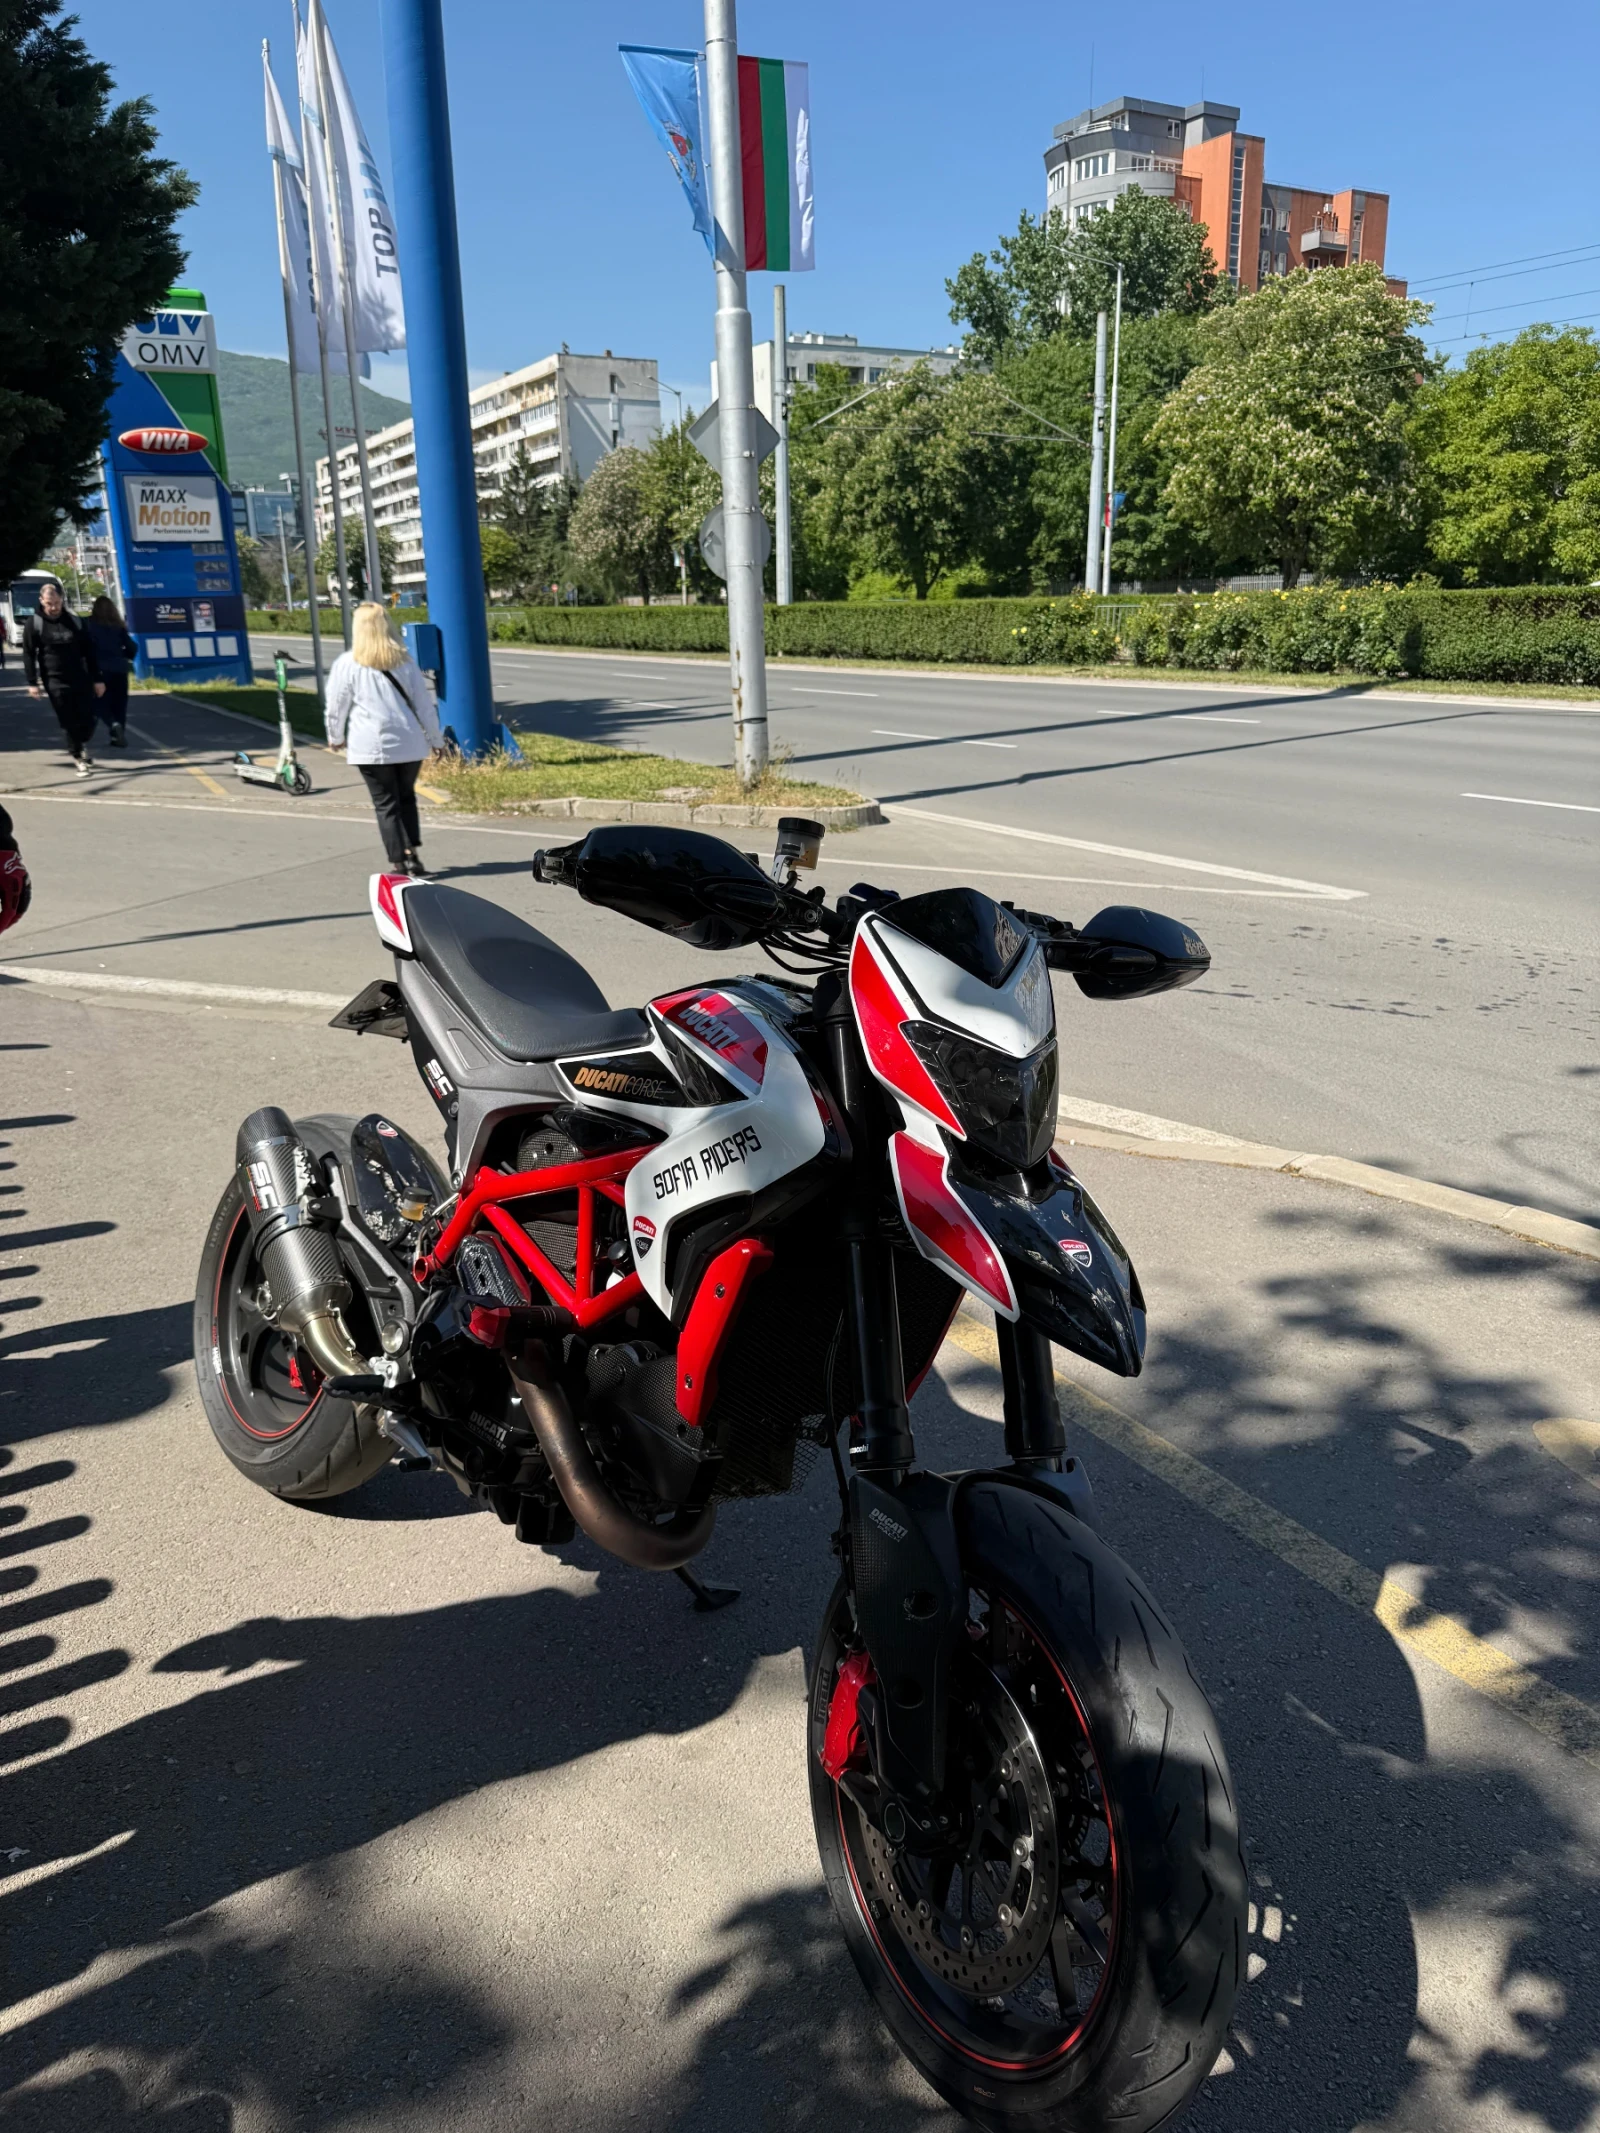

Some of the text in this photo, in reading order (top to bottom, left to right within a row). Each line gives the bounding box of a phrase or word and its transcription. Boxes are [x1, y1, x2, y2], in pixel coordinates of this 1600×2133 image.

[368, 207, 398, 278] TOP
[138, 342, 205, 366] OMV
[141, 431, 190, 451] VIVA
[140, 489, 188, 503] MAXX
[138, 505, 211, 526] Motion
[678, 1003, 740, 1049] DUCATI
[426, 1059, 454, 1096] SC
[653, 1125, 762, 1200] SOFIA RIDERS
[249, 1161, 279, 1210] SC
[634, 1219, 655, 1235] DUCATI
[469, 1410, 507, 1442] DUCATI
[870, 1507, 909, 1538] DUCATI
